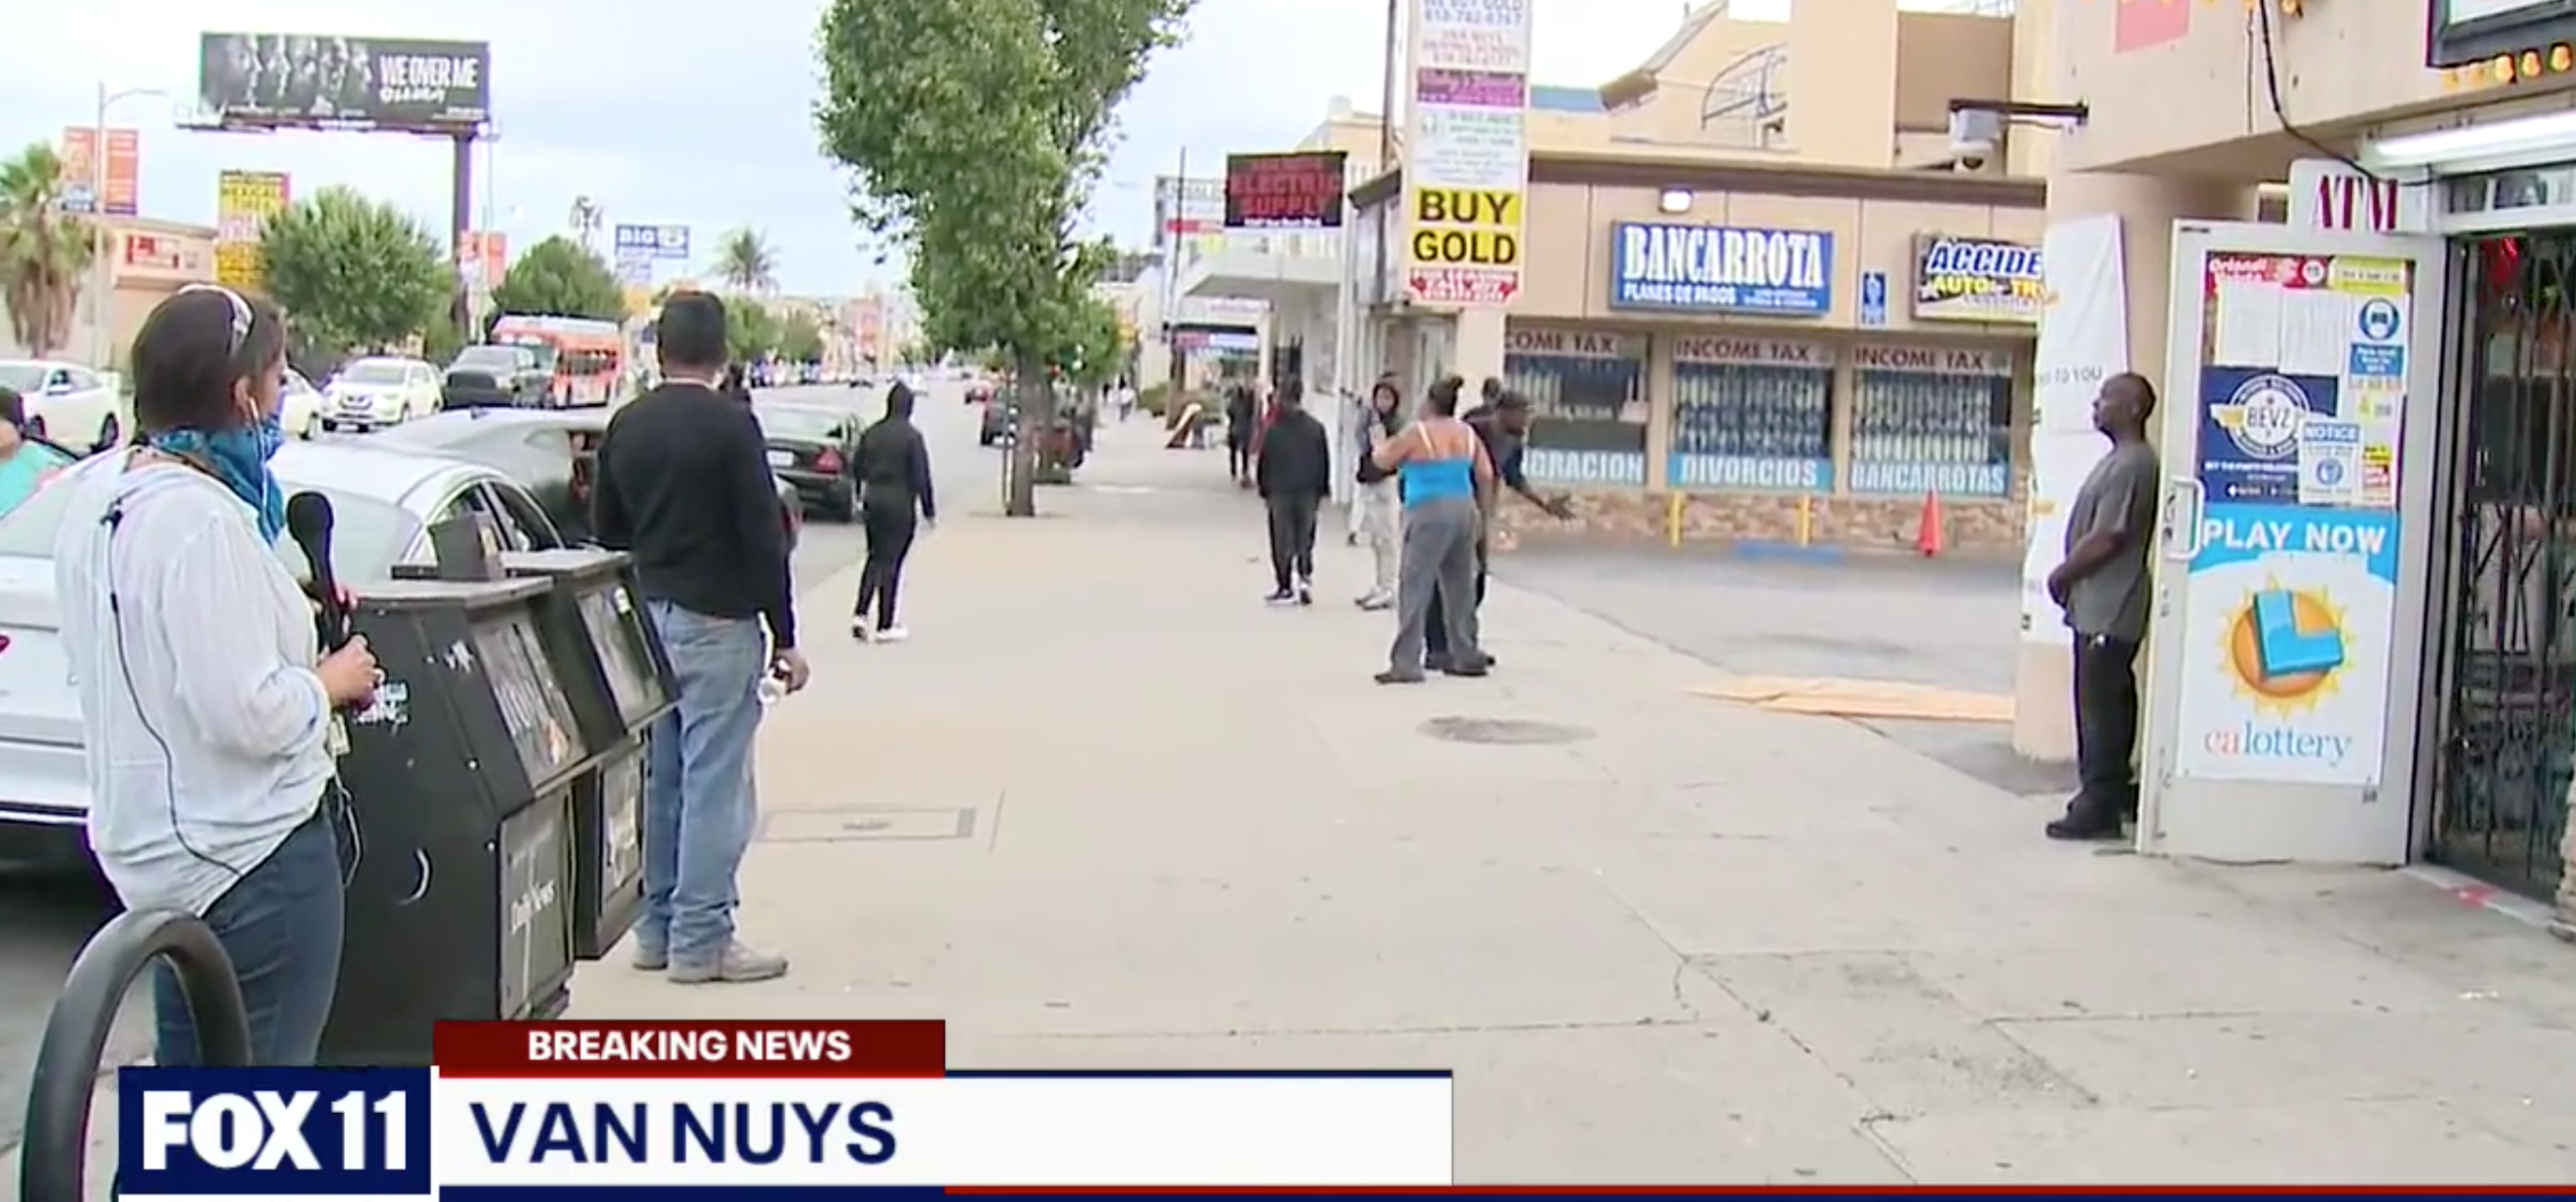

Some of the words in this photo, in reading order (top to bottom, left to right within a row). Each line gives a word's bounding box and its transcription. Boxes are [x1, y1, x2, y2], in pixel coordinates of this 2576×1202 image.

[380, 54, 408, 86] WE
[410, 55, 452, 87] OVER
[454, 57, 478, 88] ME
[1231, 173, 1340, 194] ELECTRIC
[1240, 195, 1326, 214] SUPPLY
[1419, 190, 1513, 224] BUY
[2312, 174, 2398, 231] ATM
[1414, 231, 1516, 263] GOLD
[1624, 225, 1823, 288] BANCARROTA
[1933, 275, 1989, 293] AUTO
[1575, 335, 1614, 353] TAX
[1676, 338, 1760, 359] INCOME
[1772, 341, 1809, 362] TAX
[1855, 347, 1936, 368] INCOME
[1947, 351, 1984, 370] TAX
[2305, 425, 2357, 440] NOTICE
[1681, 452, 1818, 487] DIVORCIOS
[1851, 460, 2006, 494] BANCARROTAS
[2203, 518, 2292, 549] PLAY
[2305, 522, 2388, 554] NOW
[2204, 722, 2352, 767] calottery
